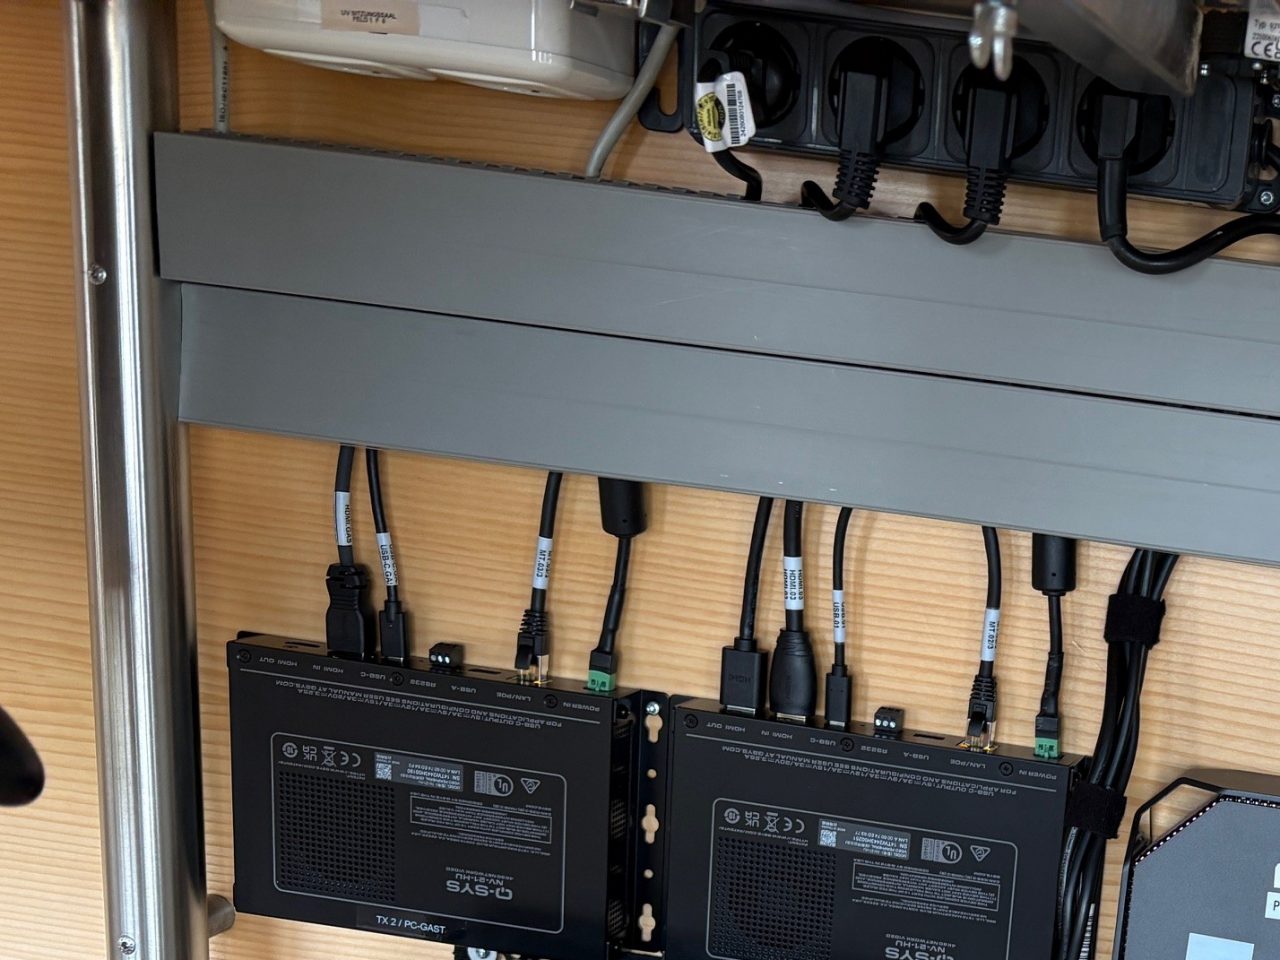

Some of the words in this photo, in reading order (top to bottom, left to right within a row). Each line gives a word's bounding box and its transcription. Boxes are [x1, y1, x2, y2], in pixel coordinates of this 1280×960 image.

[536, 549, 545, 577] MT.03/3
[788, 569, 796, 600] HDMI.03
[832, 601, 840, 628] USB.01
[986, 621, 995, 649] MT.02/3
[724, 724, 745, 732] HDMI
[771, 731, 792, 739] HDMI
[1027, 770, 1056, 779] POWER
[444, 878, 513, 900] Q-SYS
[375, 914, 389, 925] TX
[390, 917, 397, 926] 2
[403, 919, 446, 934] PC-GAST
